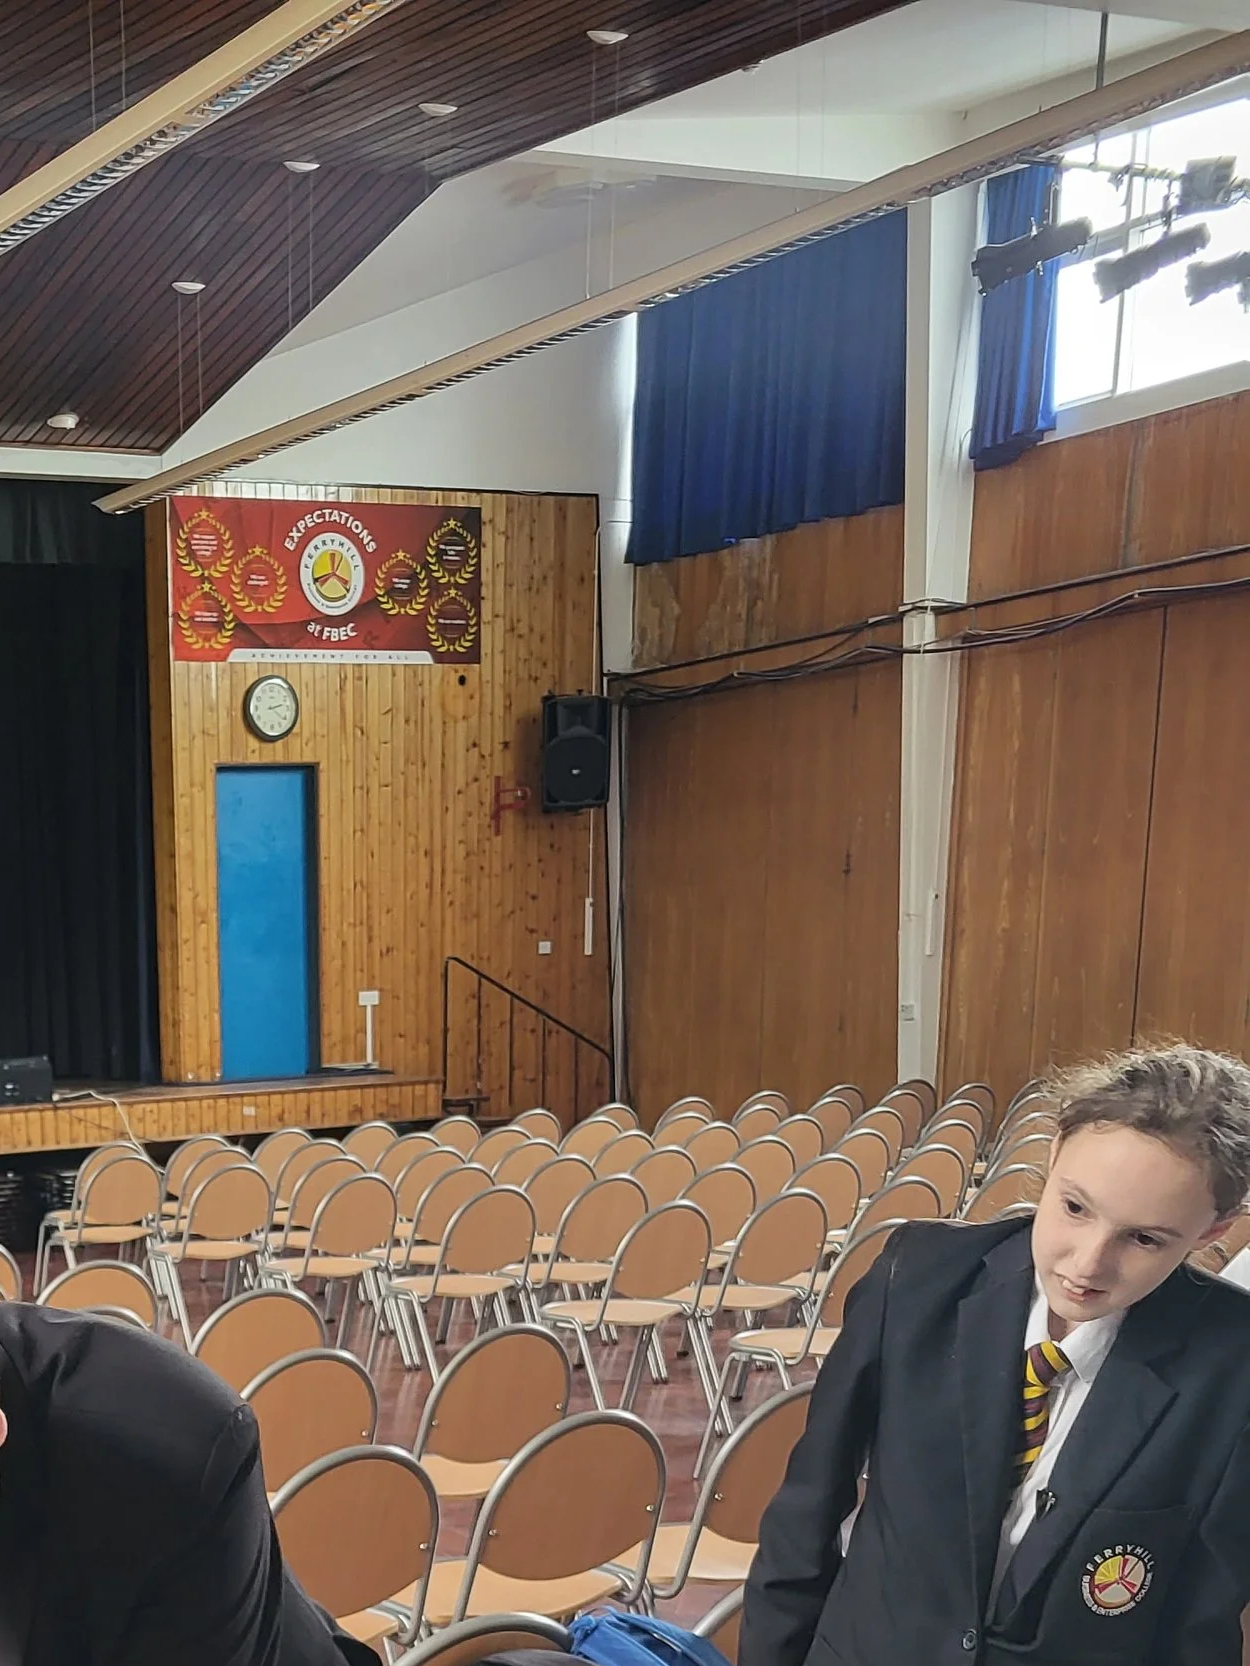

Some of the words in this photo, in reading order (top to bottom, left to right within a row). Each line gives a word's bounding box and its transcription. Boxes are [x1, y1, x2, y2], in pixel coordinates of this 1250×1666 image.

[284, 509, 377, 553] EXPECTATIONS
[304, 538, 360, 571] FERRYHILL
[306, 621, 322, 637] at
[322, 622, 358, 641] FBEC
[1086, 1544, 1155, 1571] FERRYHILL
